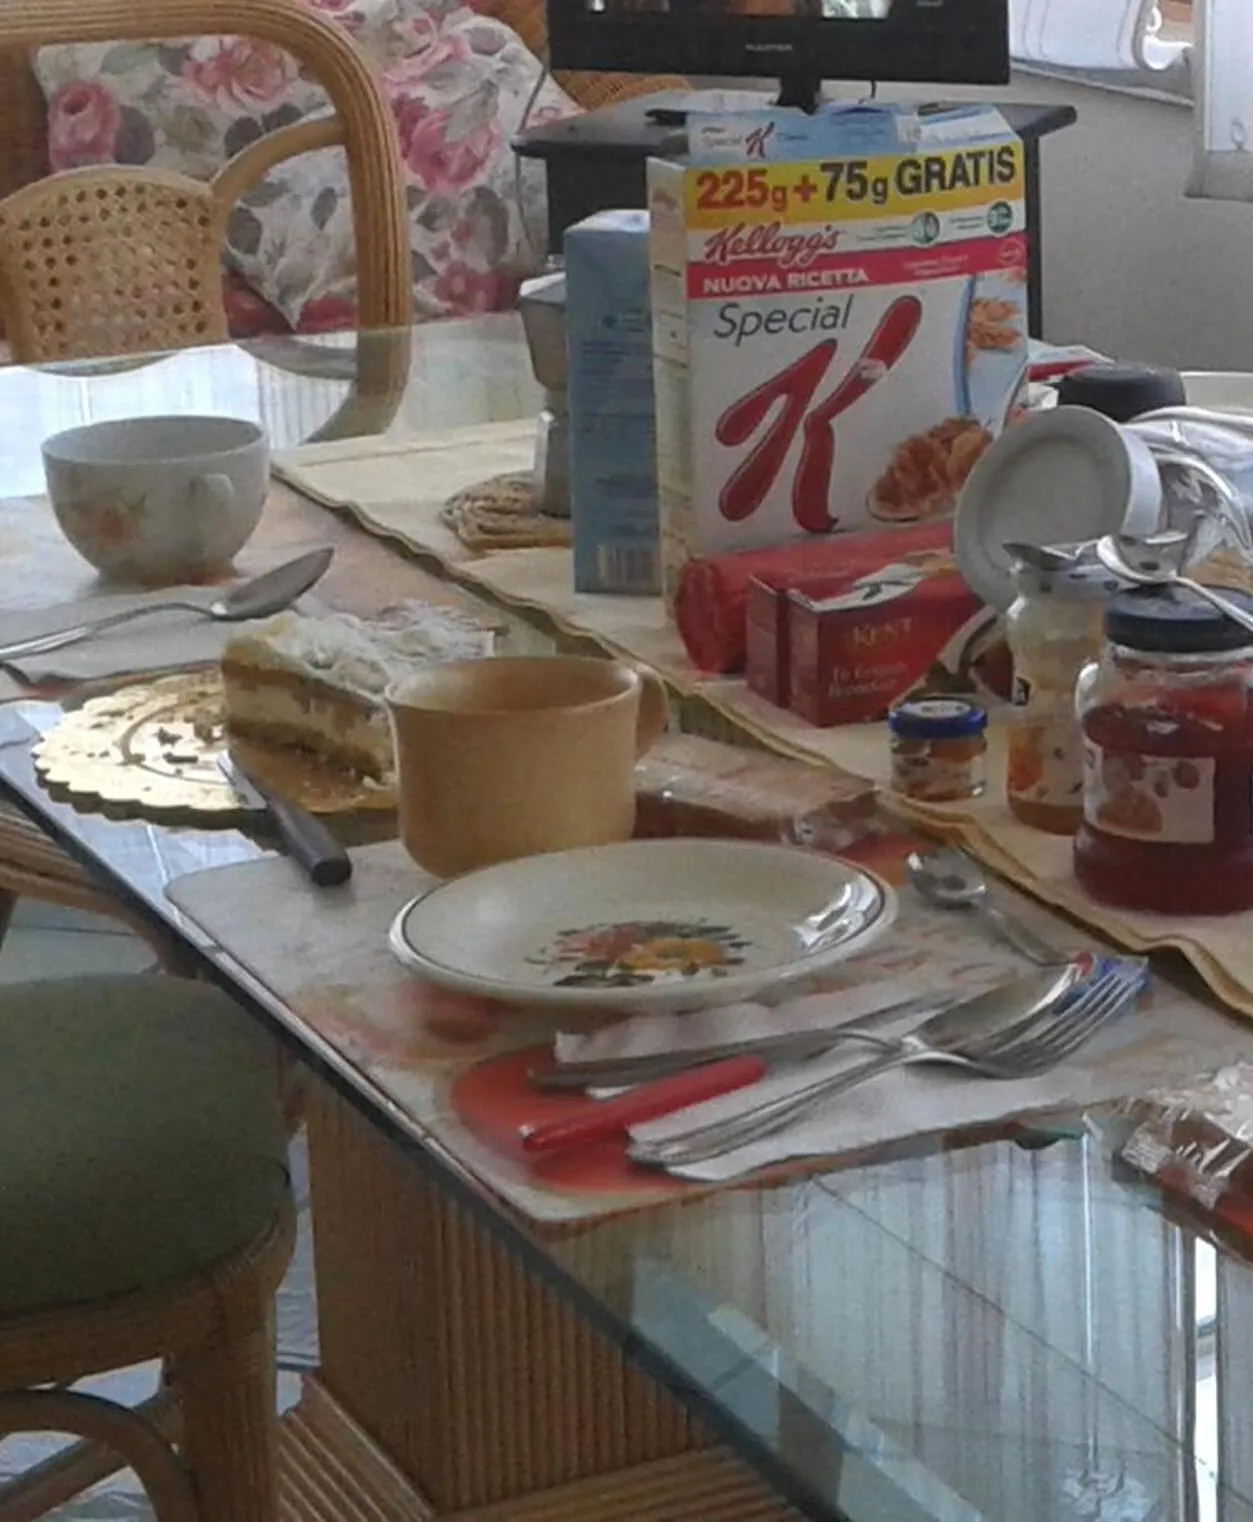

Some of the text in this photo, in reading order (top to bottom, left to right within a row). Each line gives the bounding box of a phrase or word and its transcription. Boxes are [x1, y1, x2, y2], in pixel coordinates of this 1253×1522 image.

[895, 145, 1016, 196] GRATIS
[704, 220, 848, 268] Kellogg's
[703, 267, 869, 294] NUOVA RICETTA
[713, 293, 855, 347] Special
[715, 294, 923, 533] K
